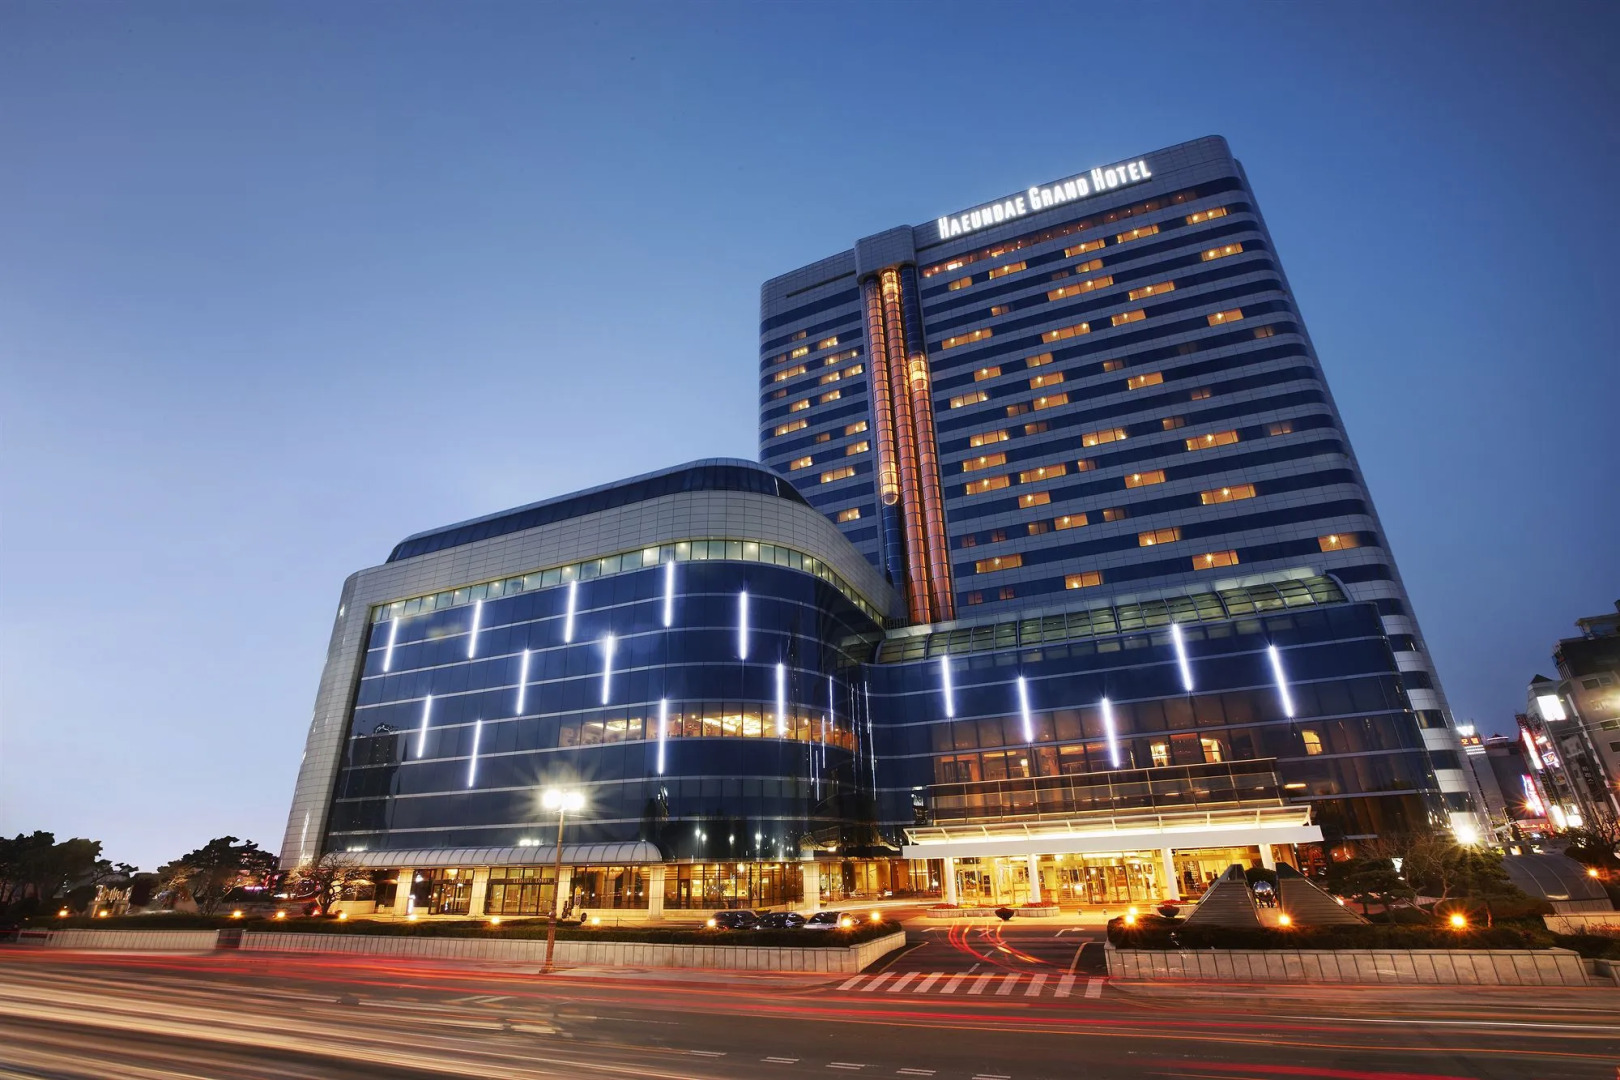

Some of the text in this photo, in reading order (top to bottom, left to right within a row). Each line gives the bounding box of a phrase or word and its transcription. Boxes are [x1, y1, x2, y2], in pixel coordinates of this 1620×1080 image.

[938, 160, 1152, 239] HAEUNDAE GRAND HOTEL
